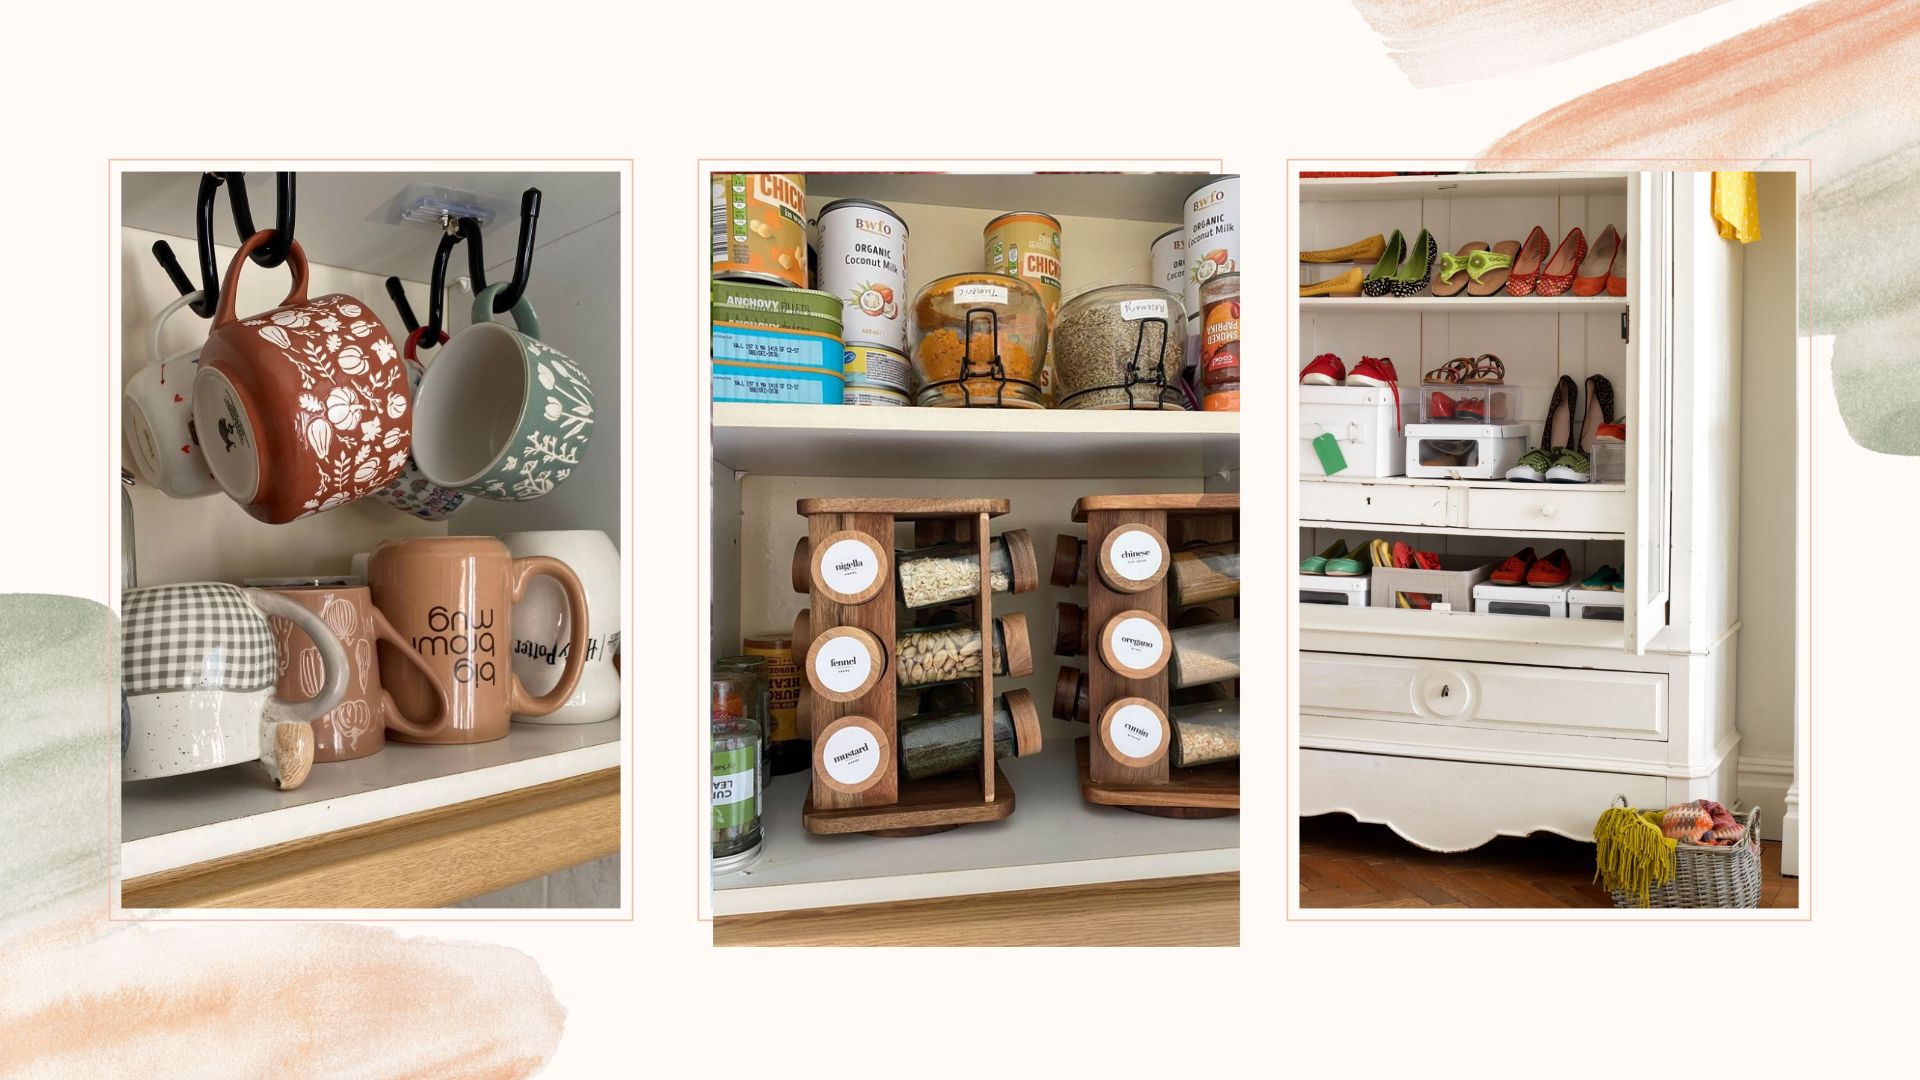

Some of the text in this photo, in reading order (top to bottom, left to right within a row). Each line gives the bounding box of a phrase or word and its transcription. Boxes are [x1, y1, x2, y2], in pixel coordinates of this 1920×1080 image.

[1192, 213, 1225, 233] ORGANIC
[1188, 223, 1235, 248] Coconut Milk
[855, 243, 892, 259] ORGANIC
[845, 254, 898, 275] Coconut Milk
[727, 296, 811, 312] ANCHOVY FILLETS
[1124, 302, 1166, 313] Rosemary
[1207, 320, 1238, 334] PAPRIKA
[1207, 331, 1238, 345] SMOKED
[1121, 550, 1151, 559] chinese
[835, 559, 863, 572] nigella
[428, 605, 494, 631] mug
[1121, 636, 1153, 648] oregano
[514, 640, 557, 665] Potter
[830, 656, 857, 668] fennel
[454, 658, 496, 688] big
[1124, 722, 1149, 738] cumin
[833, 742, 869, 764] mustard
